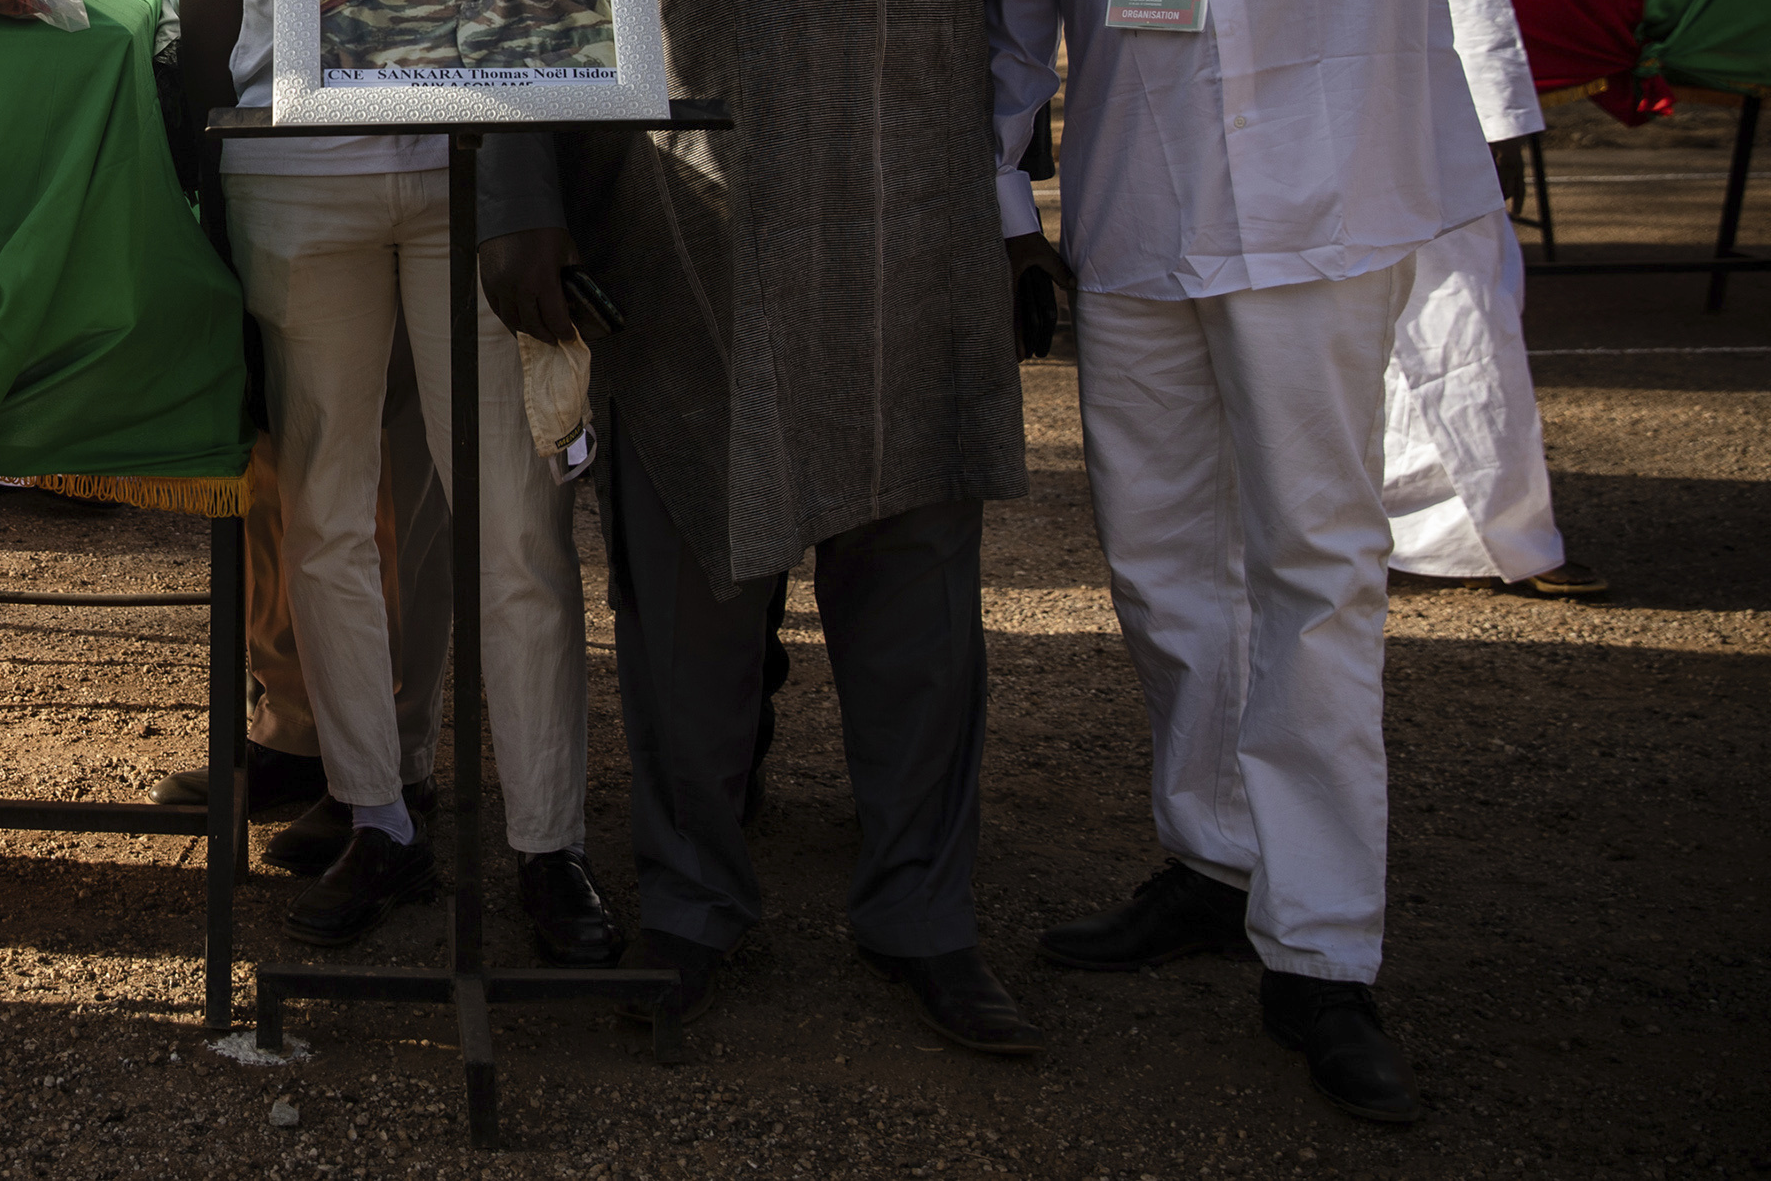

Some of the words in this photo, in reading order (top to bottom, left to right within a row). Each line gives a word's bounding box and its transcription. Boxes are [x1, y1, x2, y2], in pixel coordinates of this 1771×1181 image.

[1122, 9, 1180, 20] ORGANISATION
[328, 69, 364, 80] CNE
[378, 69, 463, 79] SANKARA
[468, 69, 528, 79] Thomas
[534, 68, 567, 79] Noël
[572, 68, 616, 79] Isidor
